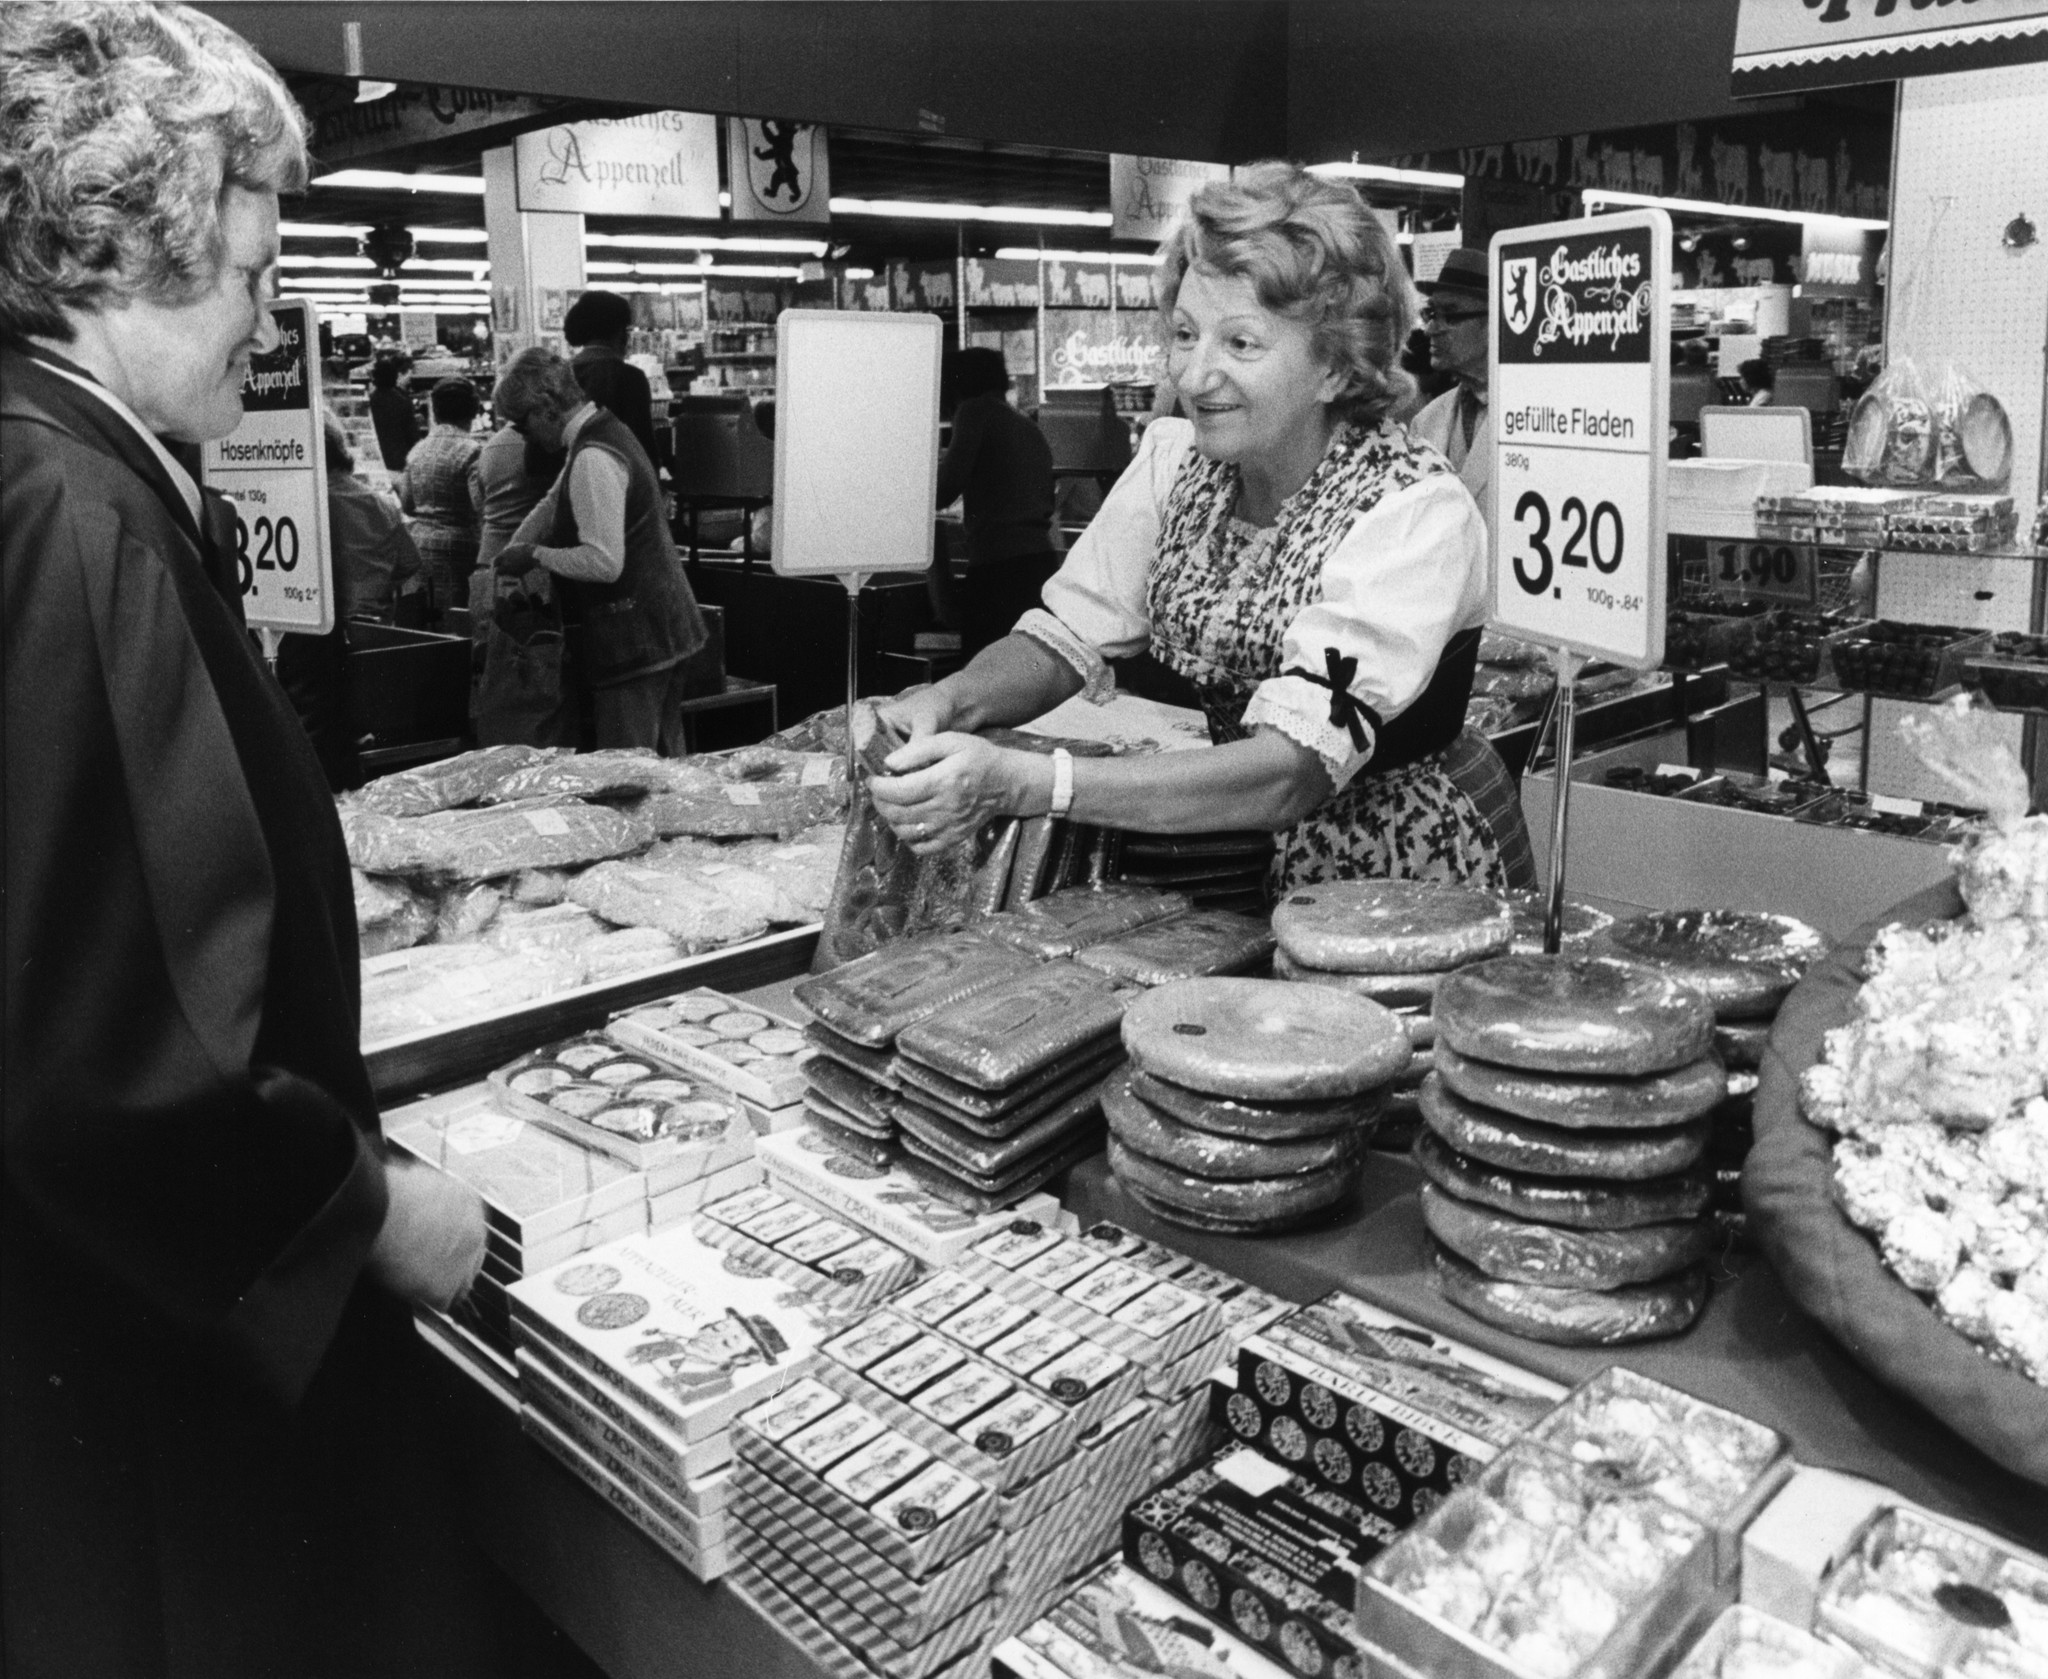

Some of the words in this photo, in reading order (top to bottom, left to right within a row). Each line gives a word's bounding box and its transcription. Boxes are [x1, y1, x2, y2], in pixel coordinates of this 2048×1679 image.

[541, 127, 684, 190] Appenzell
[1540, 243, 1641, 288] Gastliches
[1536, 284, 1651, 354] Appenzell
[1505, 406, 1568, 435] gefüllte
[1571, 408, 1634, 438] Fladen
[219, 439, 305, 462] Hosenknöpfe
[1505, 453, 1529, 471] 380g
[1512, 490, 1624, 600] 3.20
[1718, 544, 1798, 587] 1.90
[1587, 587, 1614, 610] 100g
